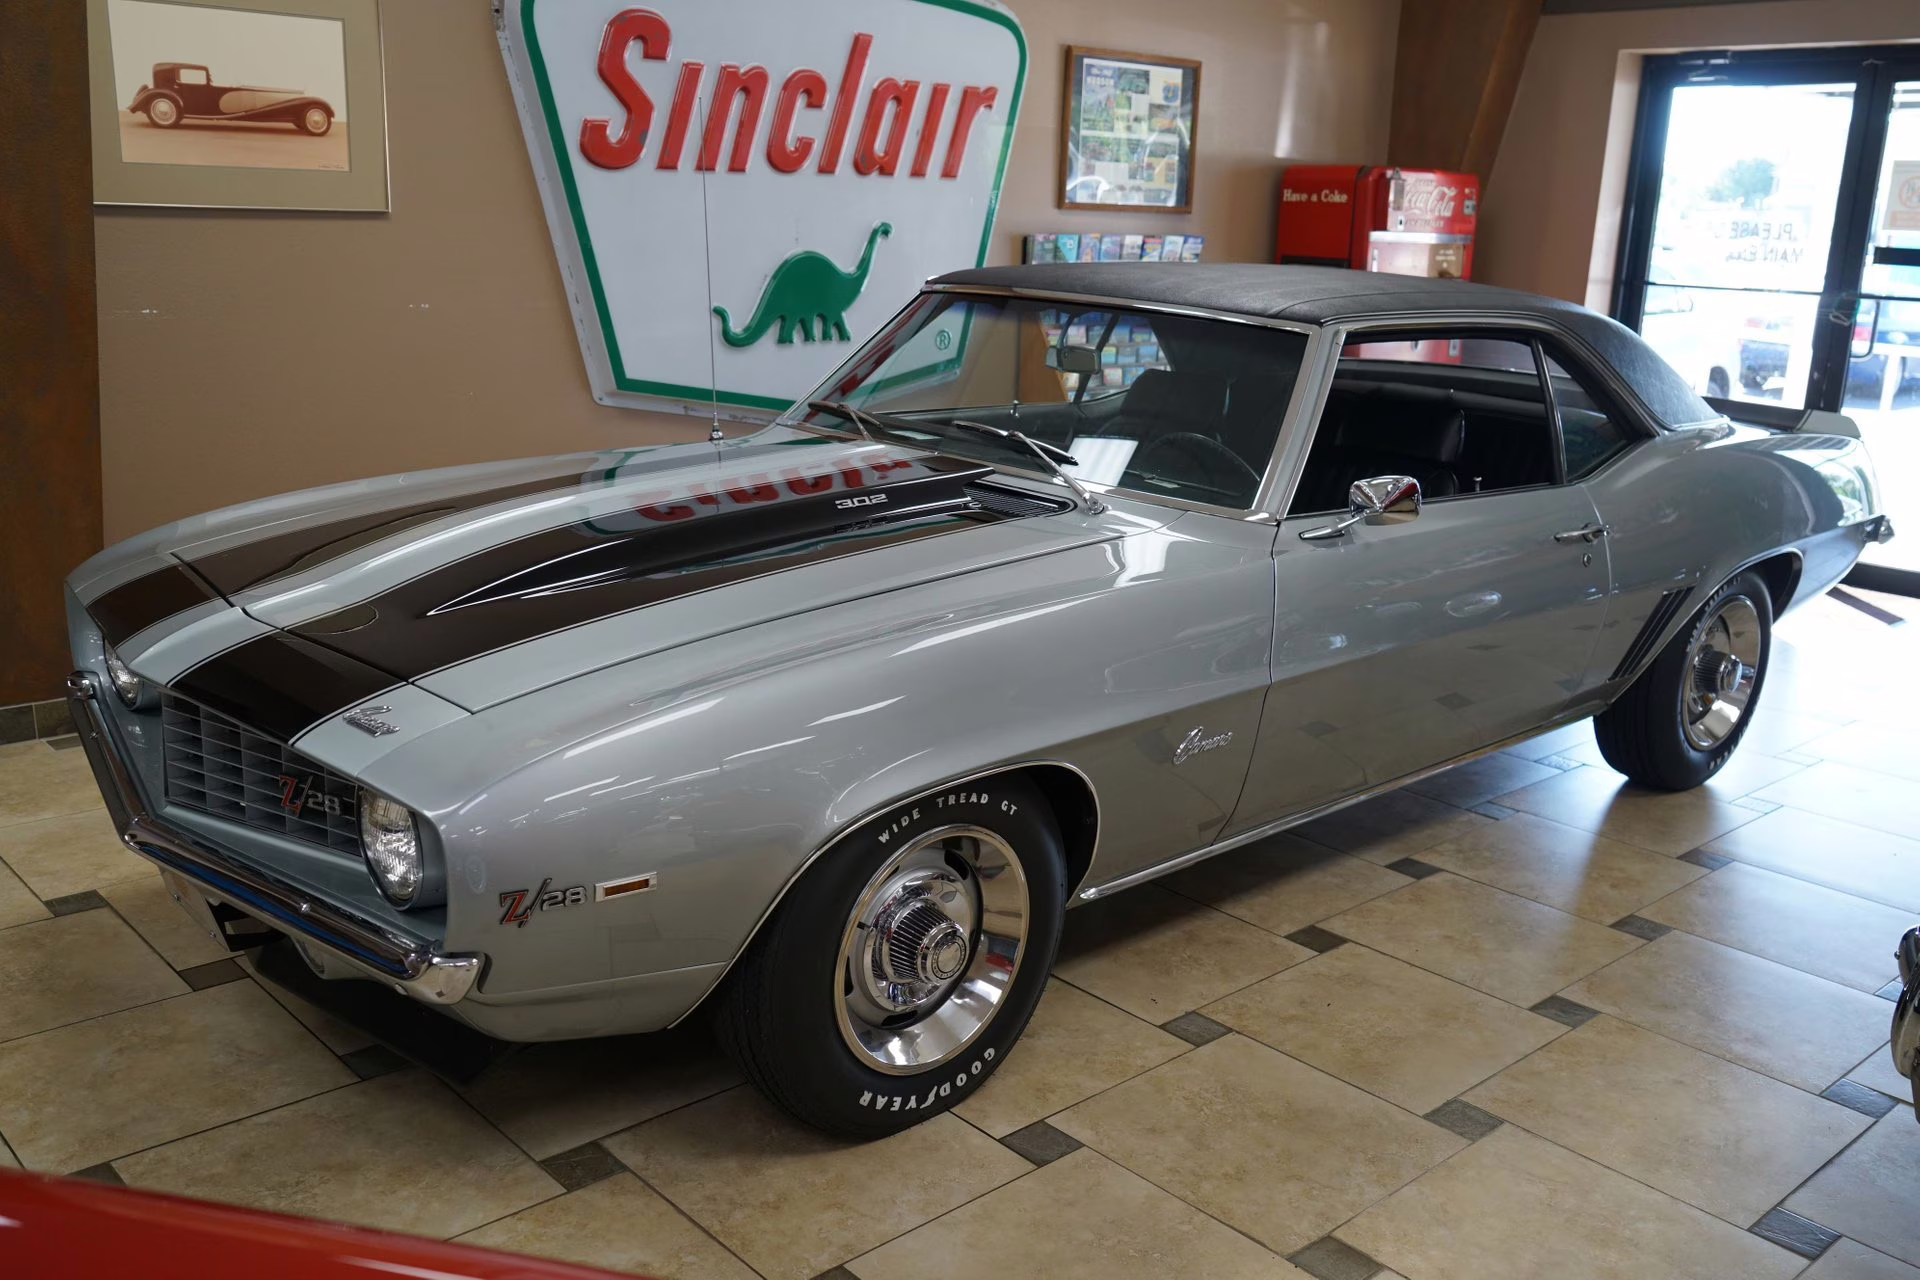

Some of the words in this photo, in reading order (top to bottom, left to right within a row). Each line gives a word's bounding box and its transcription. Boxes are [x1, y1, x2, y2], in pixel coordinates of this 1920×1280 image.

[579, 7, 998, 179] Sinclair
[1283, 189, 1308, 203] Have
[1311, 192, 1318, 203] a
[1321, 189, 1348, 203] Coke
[834, 493, 889, 510] 302
[279, 775, 341, 817] Z/28
[877, 807, 921, 844] WIDE
[935, 792, 989, 808] TREAD
[1001, 799, 1018, 816] GT
[499, 877, 588, 928] Z/28
[859, 1047, 996, 1111] GOODYEAR
